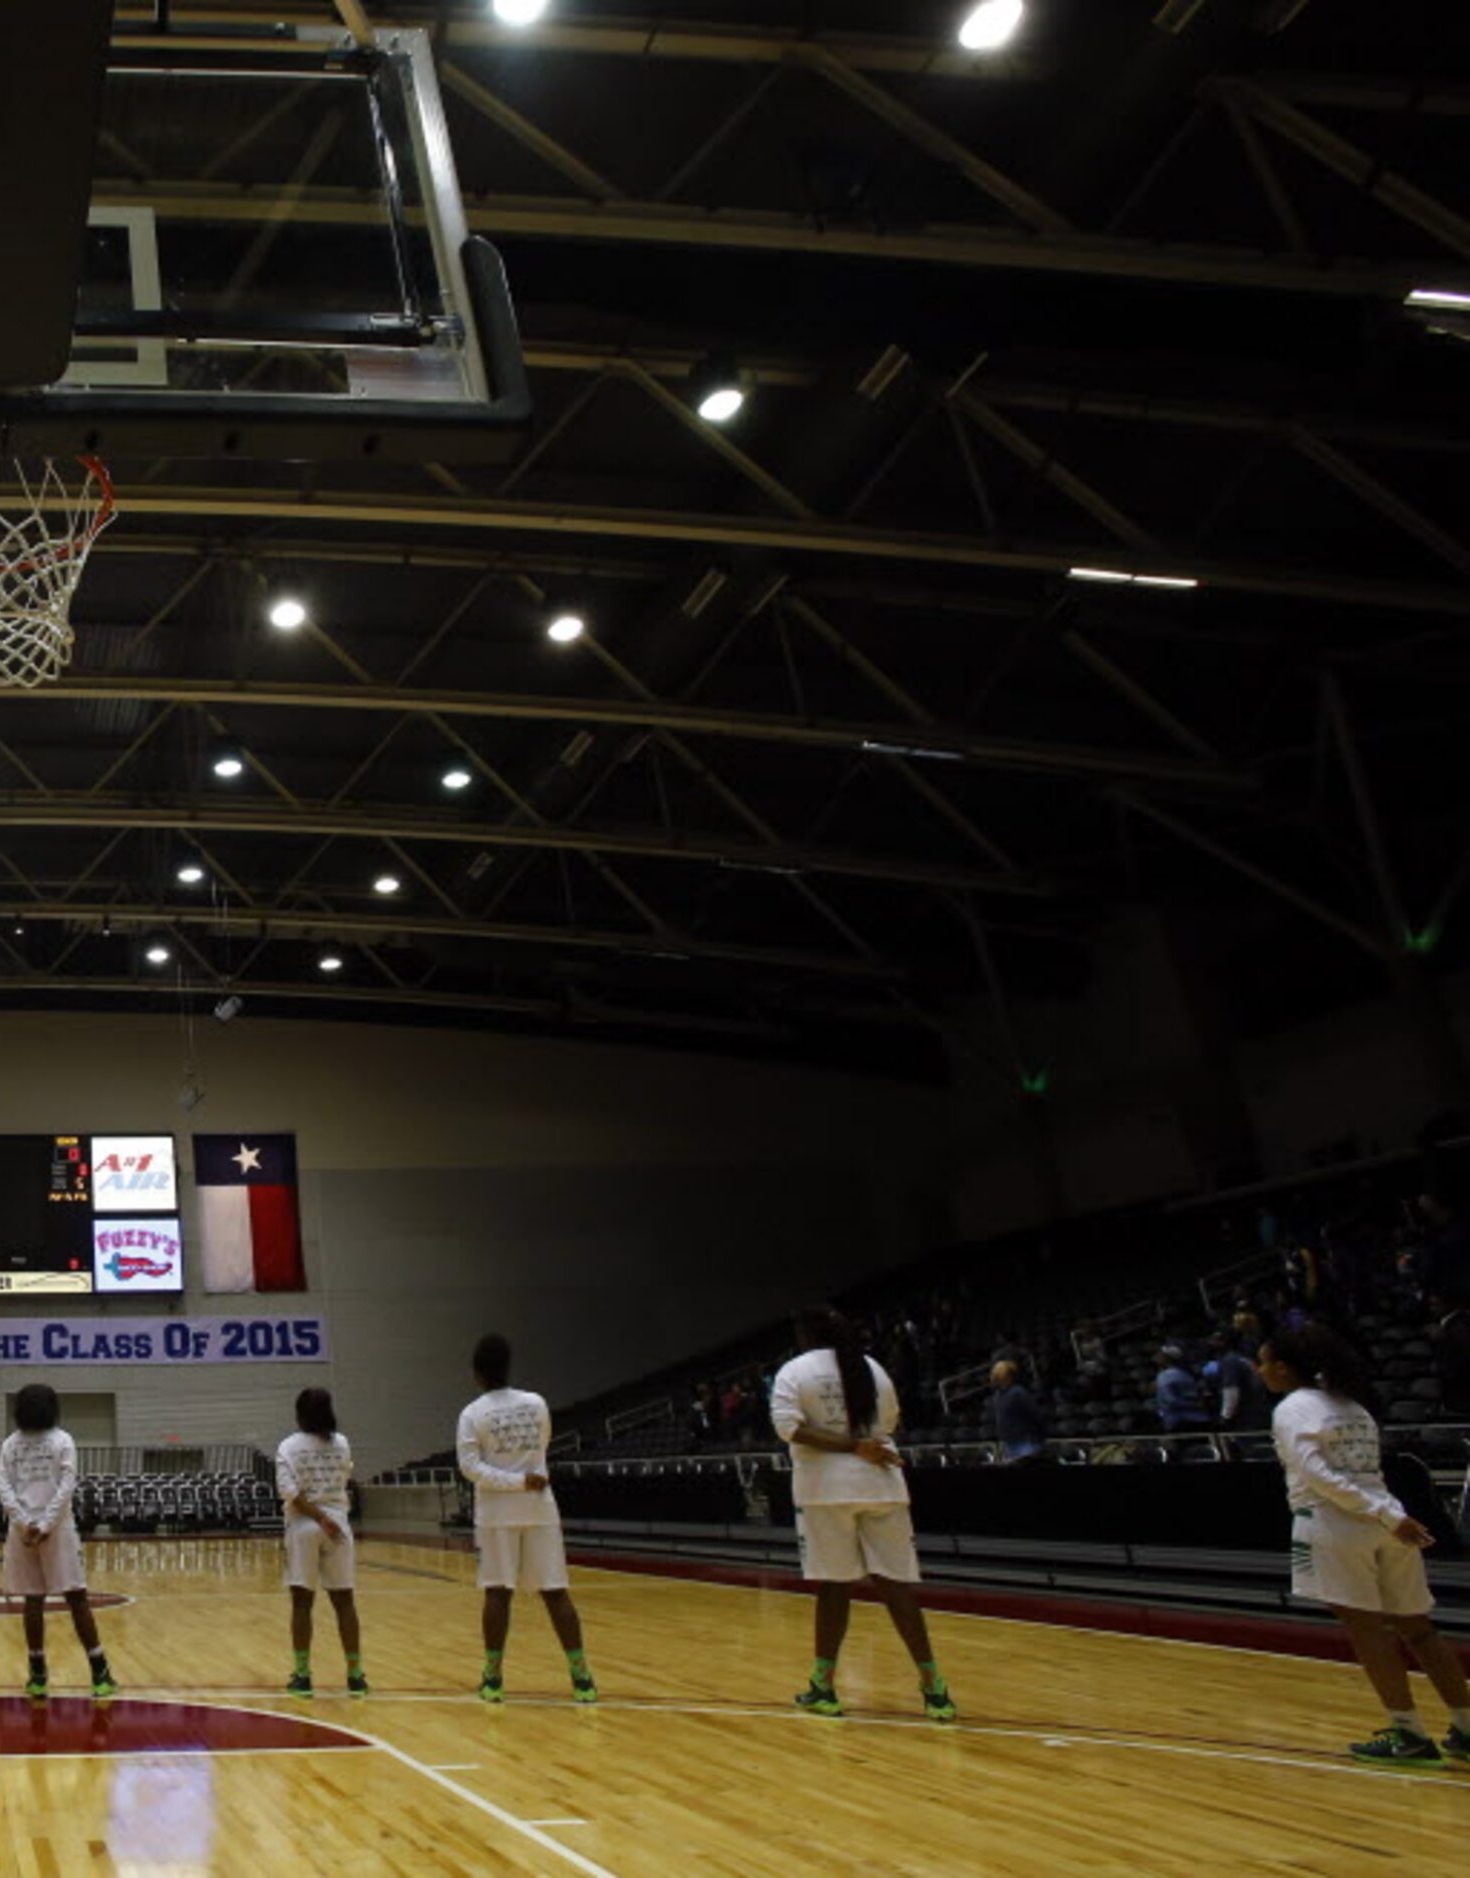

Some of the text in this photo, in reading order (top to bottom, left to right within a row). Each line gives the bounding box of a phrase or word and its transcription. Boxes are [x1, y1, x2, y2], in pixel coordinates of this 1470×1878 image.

[98, 1173, 170, 1191] AIR
[97, 1229, 178, 1256] FUZZY'S
[221, 1321, 320, 1356] 2015
